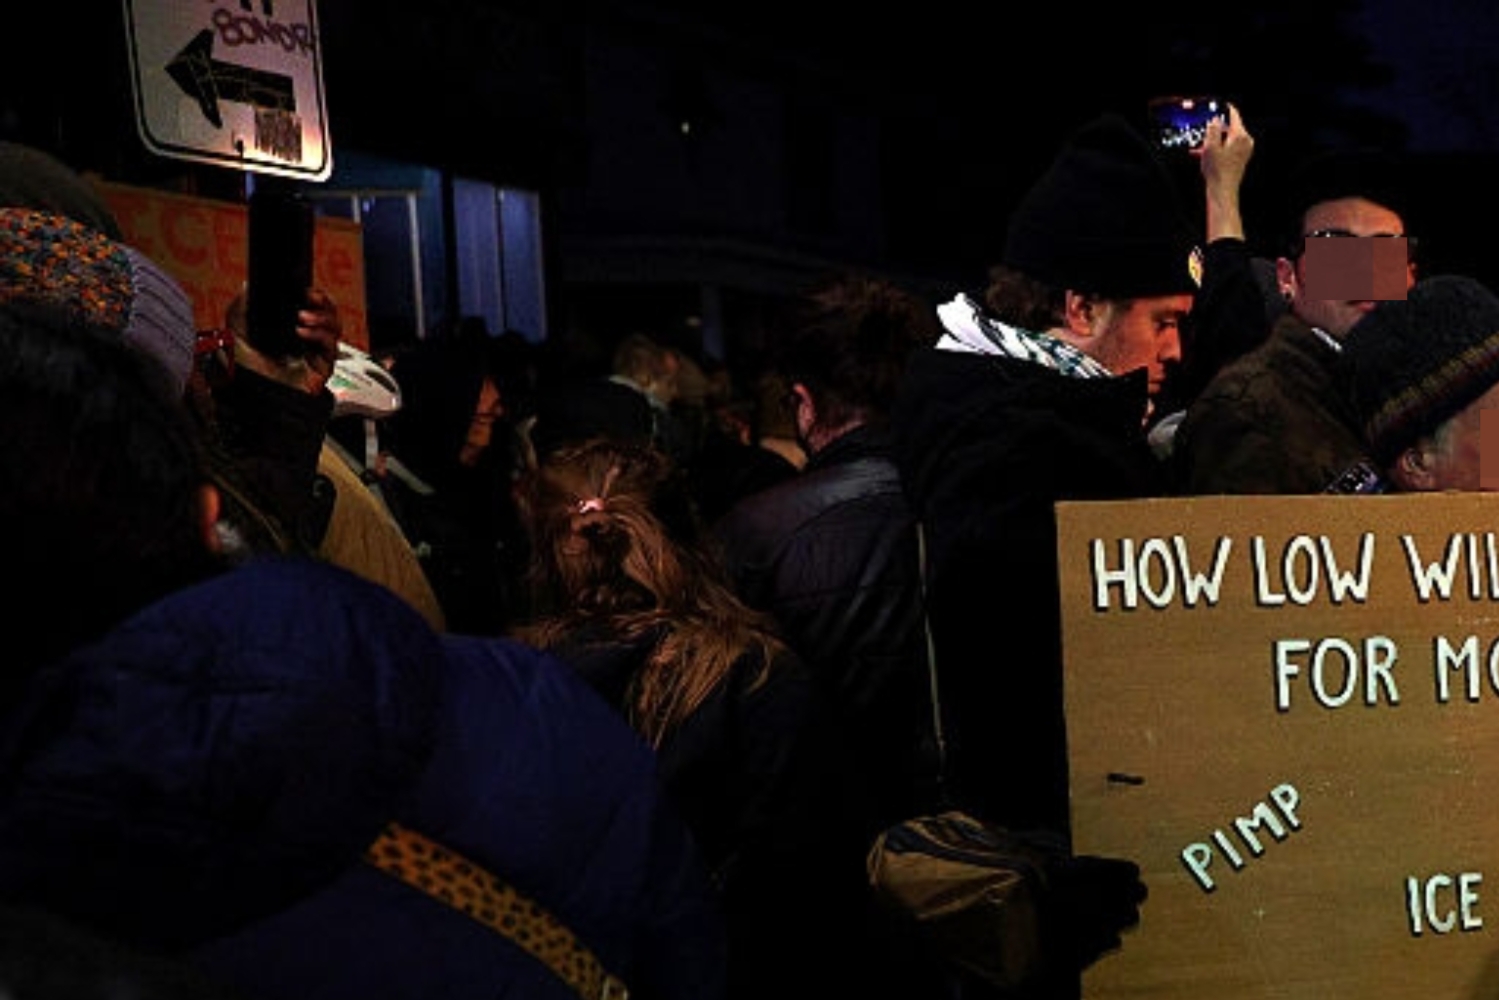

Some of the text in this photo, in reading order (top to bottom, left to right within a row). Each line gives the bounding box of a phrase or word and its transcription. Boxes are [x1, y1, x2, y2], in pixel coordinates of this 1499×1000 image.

[1093, 535, 1233, 608] HOW
[1254, 532, 1375, 605] LOW
[1276, 635, 1400, 710] FOR
[1181, 782, 1301, 889] PIMP
[1407, 872, 1483, 933] ICE
